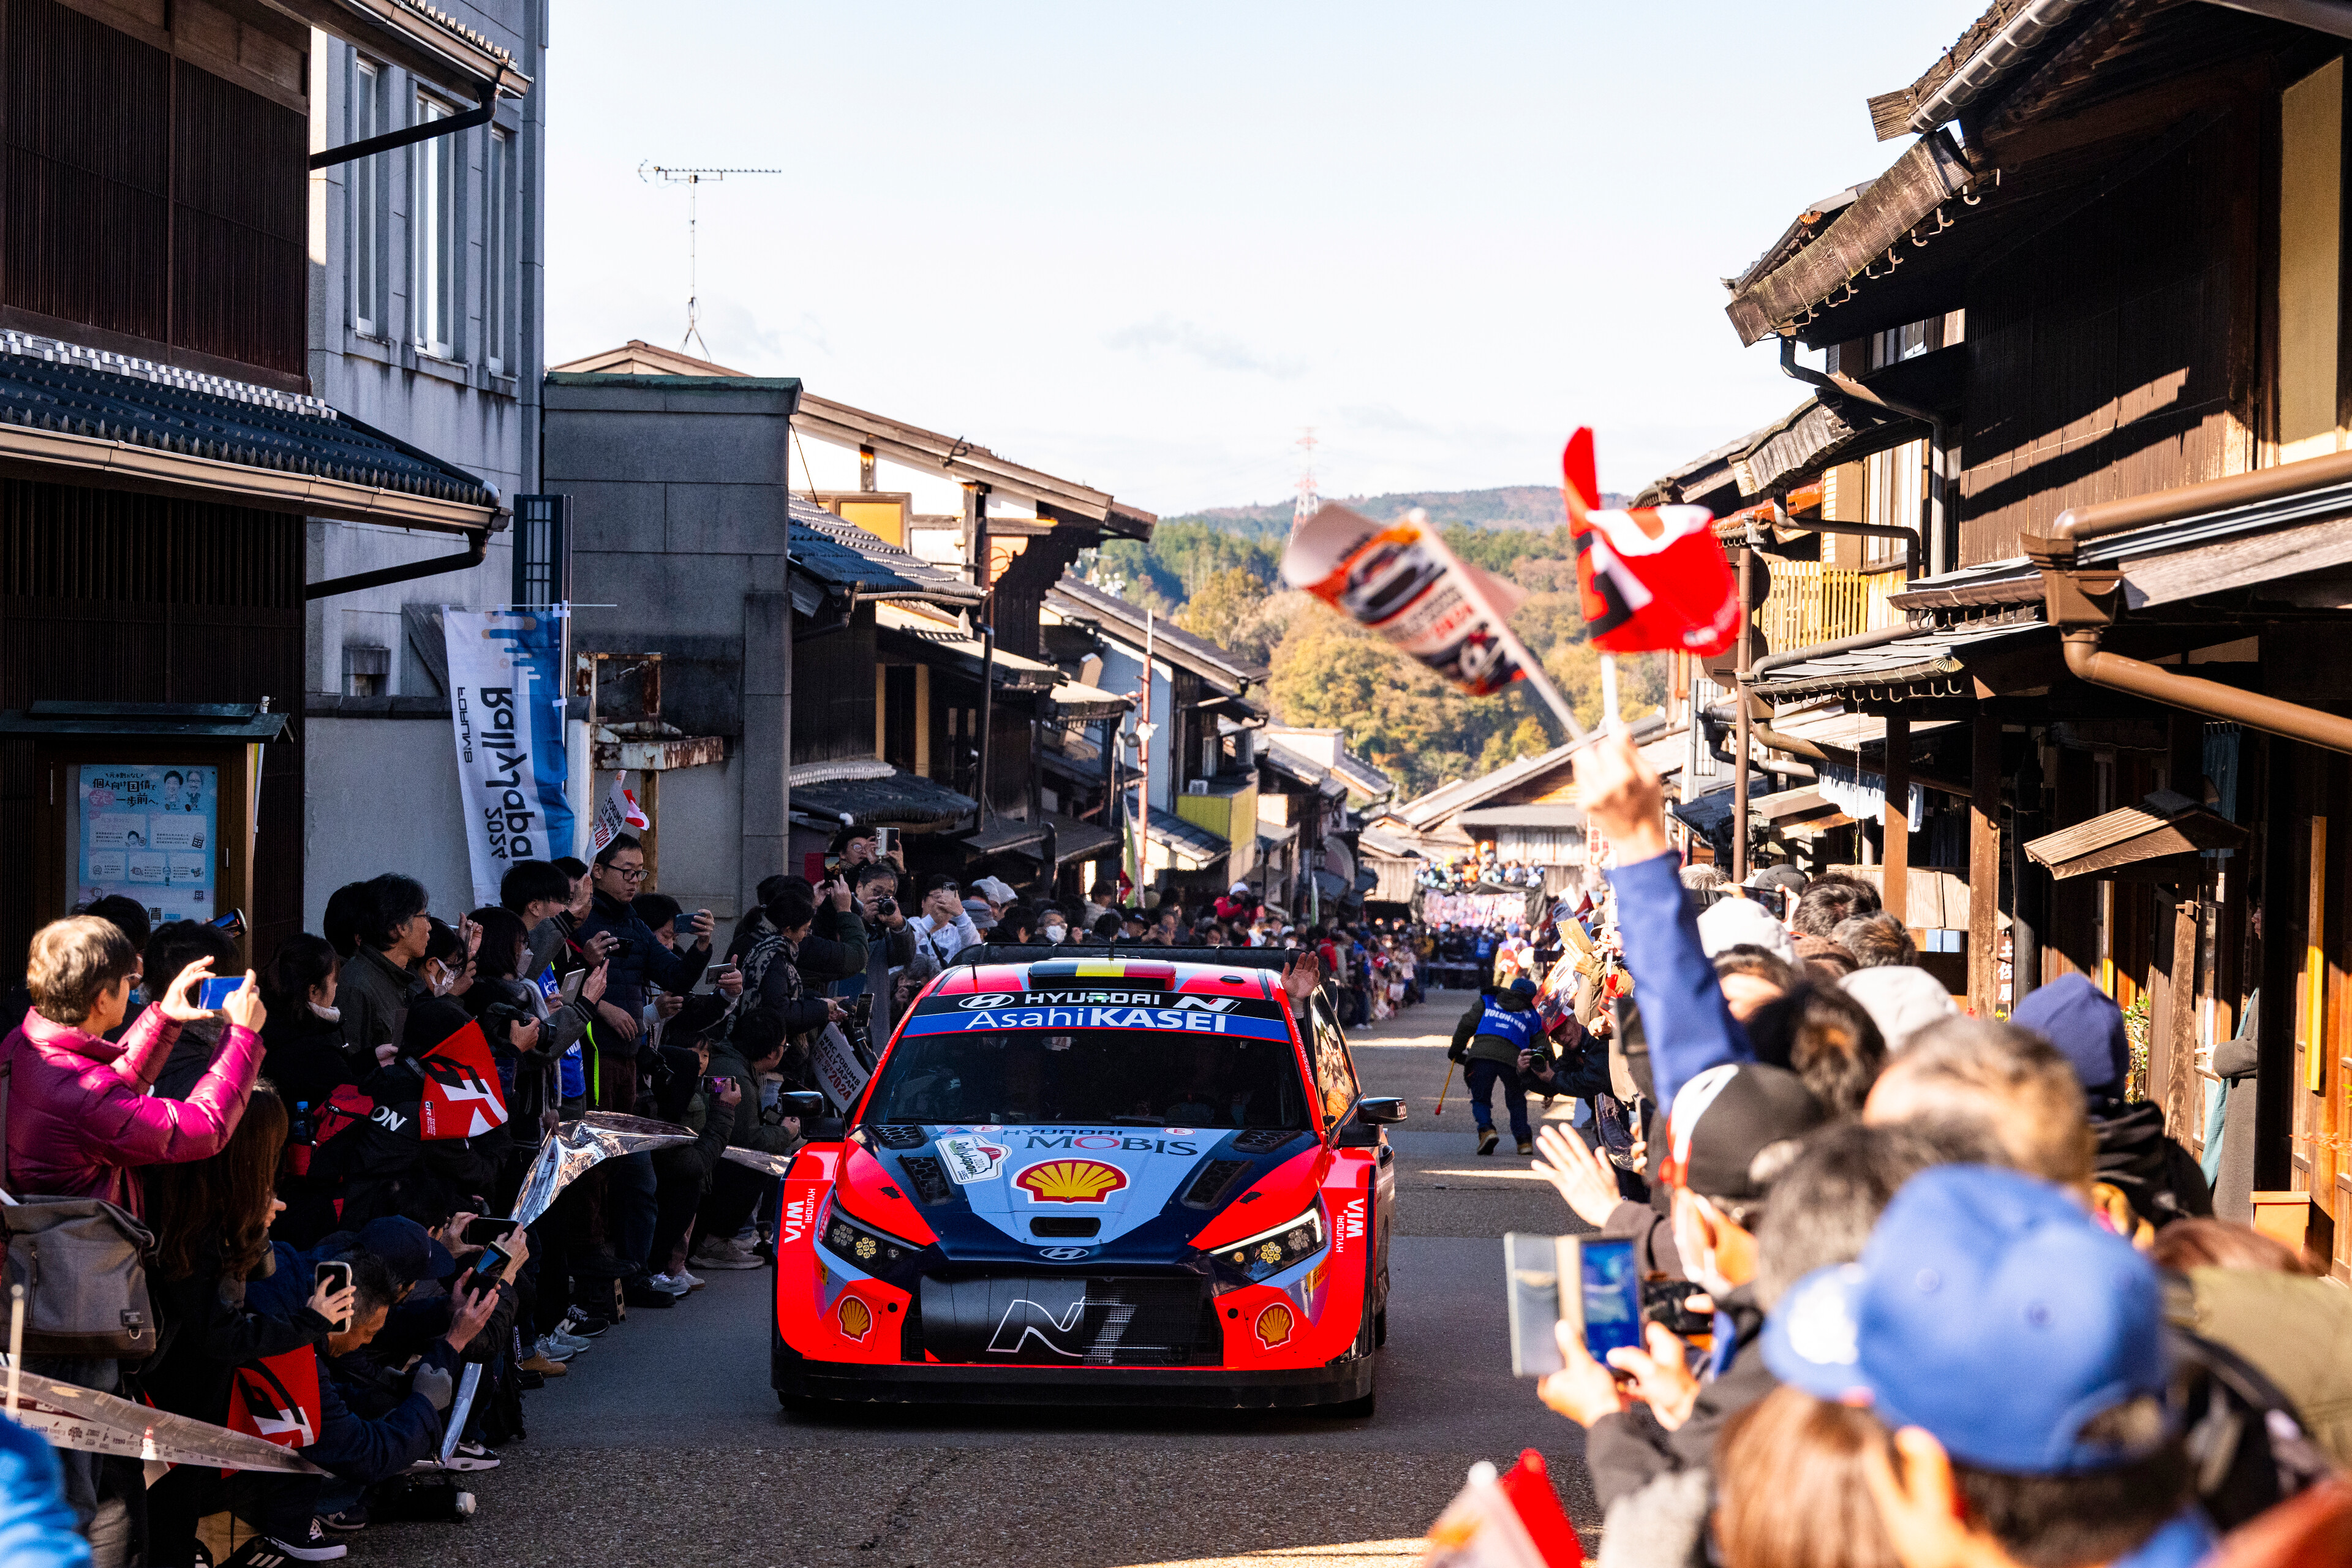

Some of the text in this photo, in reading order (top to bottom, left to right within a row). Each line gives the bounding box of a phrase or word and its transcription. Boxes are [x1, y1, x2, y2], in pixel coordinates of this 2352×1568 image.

[606, 813, 619, 837] JAPAN
[607, 796, 623, 827] FORUM8
[1025, 992, 1160, 1006] HYUNDAI
[819, 1040, 838, 1065] RALLY
[835, 1066, 857, 1092] JAPAN
[823, 1033, 837, 1054] WRC
[835, 1052, 861, 1086] FORUM8
[827, 1070, 852, 1101] 2024
[1025, 1135, 1199, 1156] MOBIS
[973, 1158, 986, 1169] 2024
[804, 1188, 816, 1223] HYUNDAI
[1335, 1215, 1345, 1253] HYUNDAI
